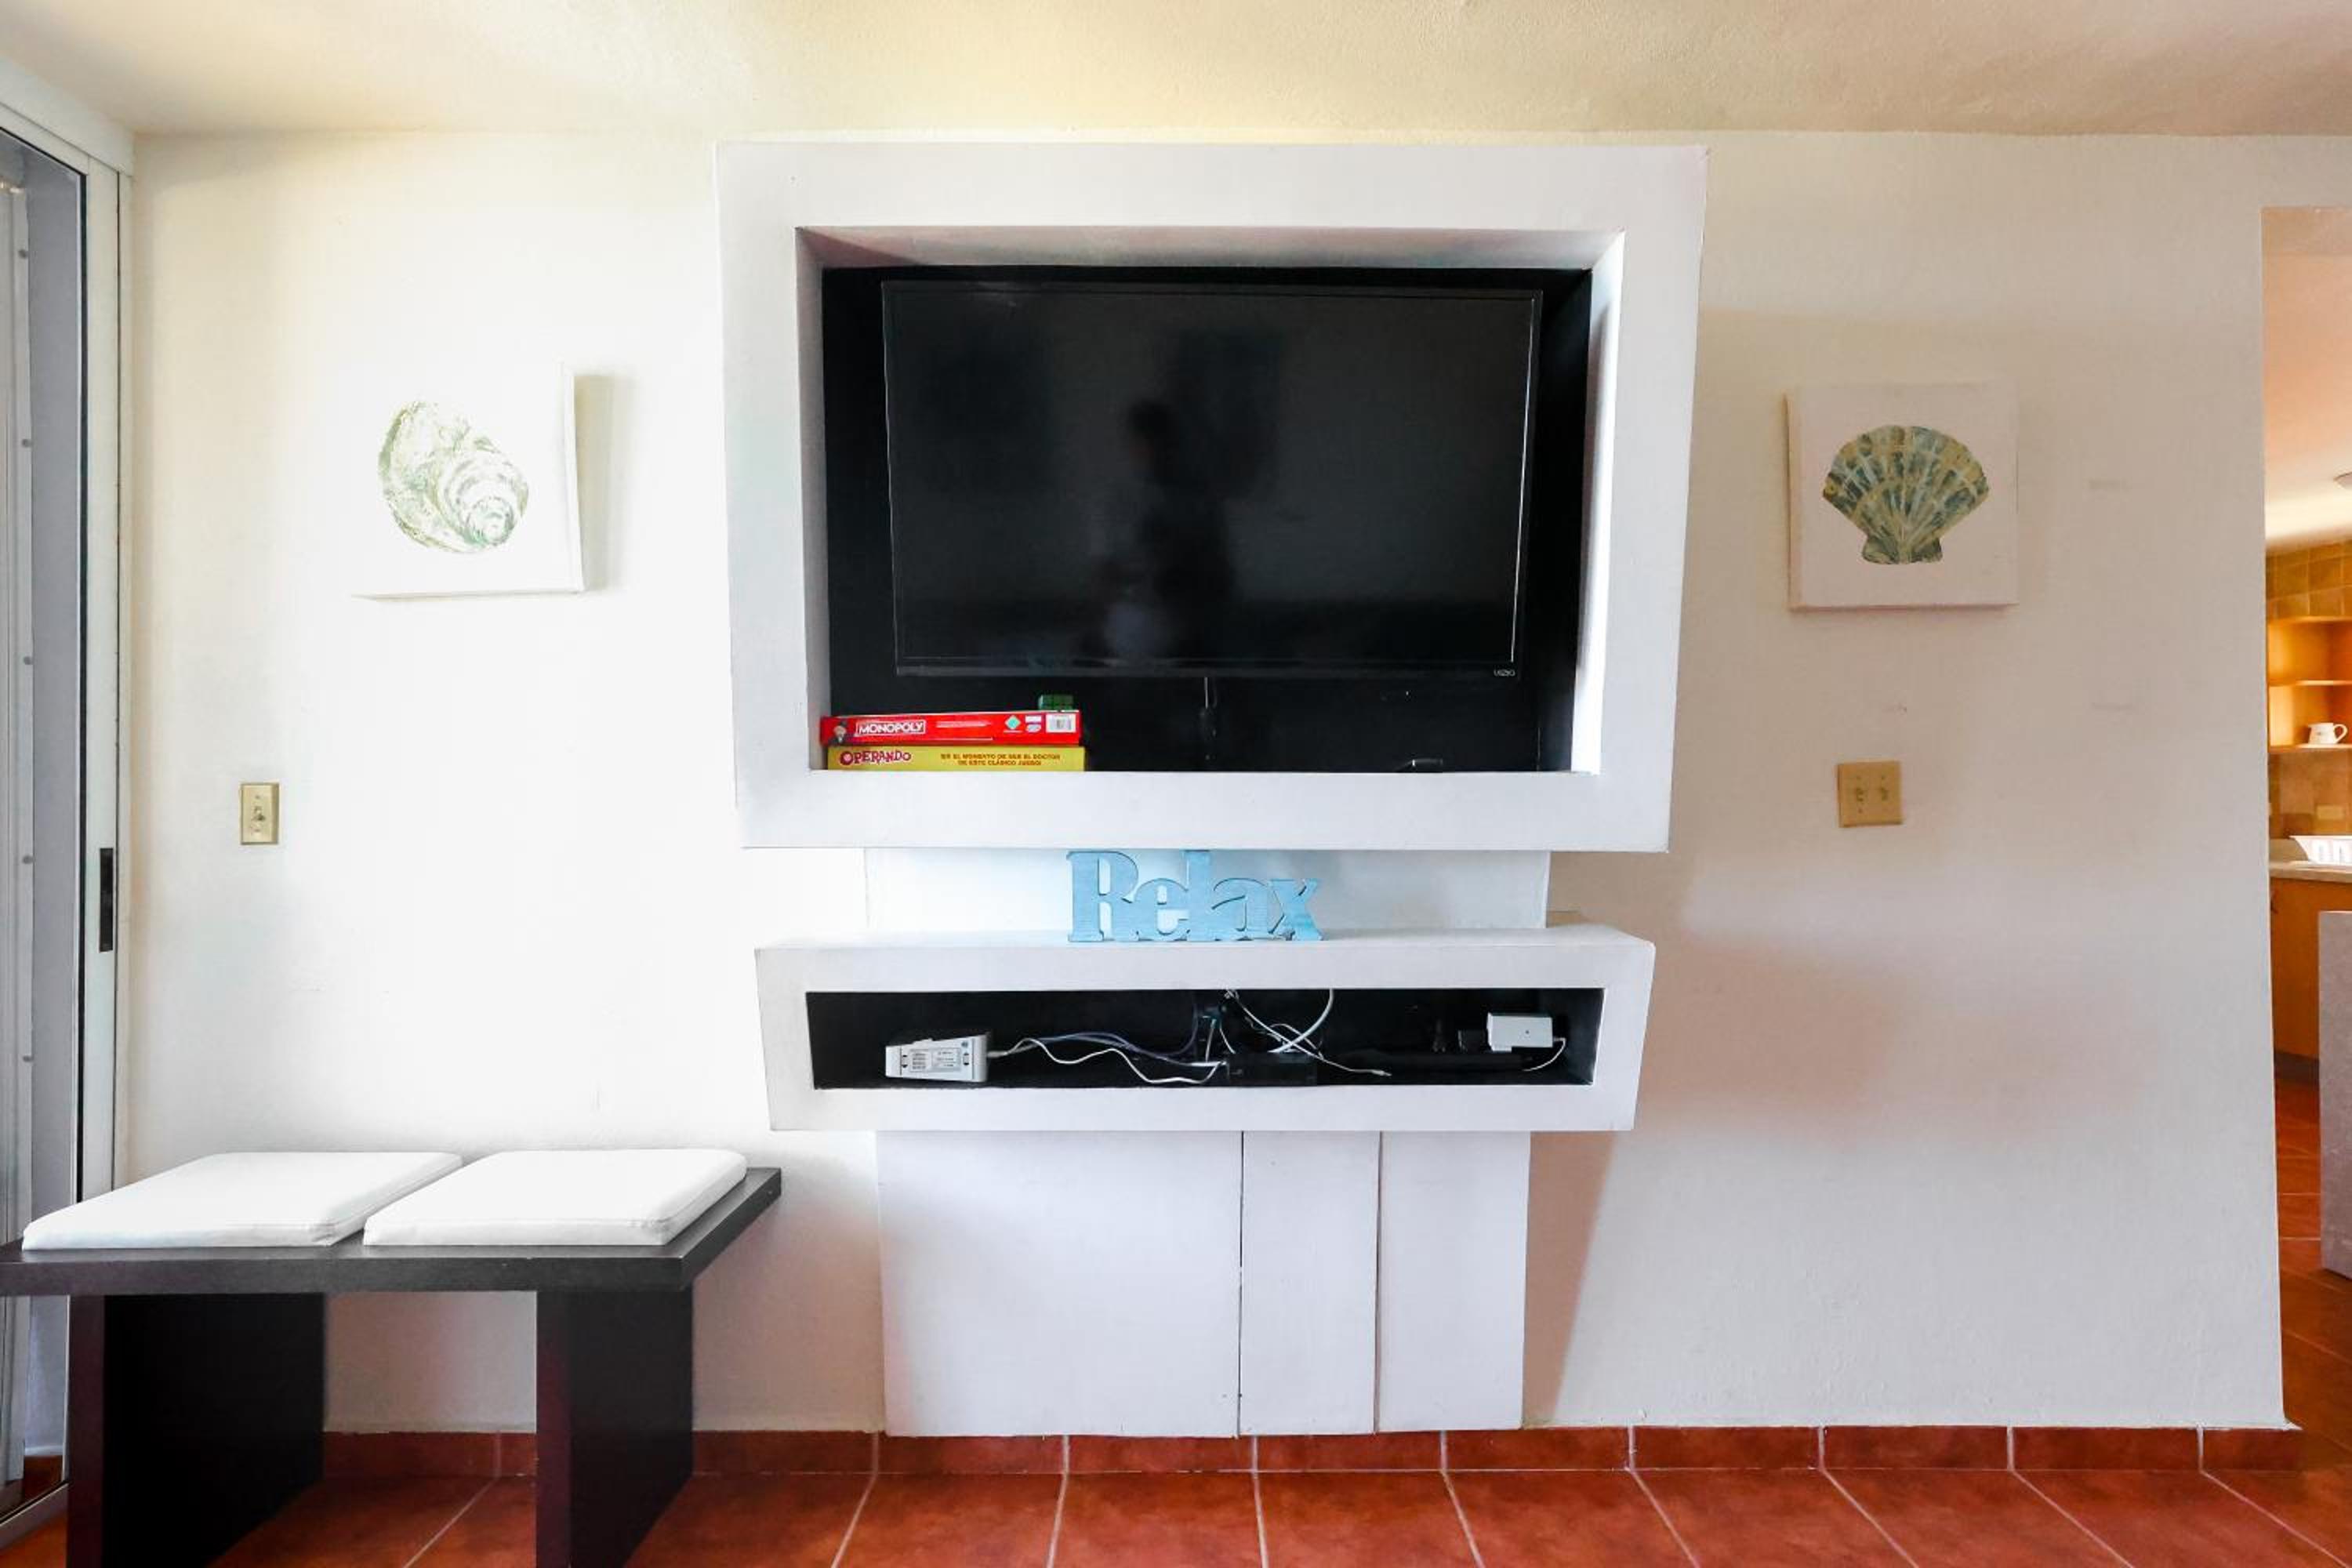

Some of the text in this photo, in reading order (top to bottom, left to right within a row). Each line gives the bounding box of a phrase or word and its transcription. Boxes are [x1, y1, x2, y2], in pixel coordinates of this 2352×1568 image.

[858, 720, 924, 734] MONOPOLY
[840, 750, 911, 765] OPERANDO
[1066, 850, 1323, 942] Relax
